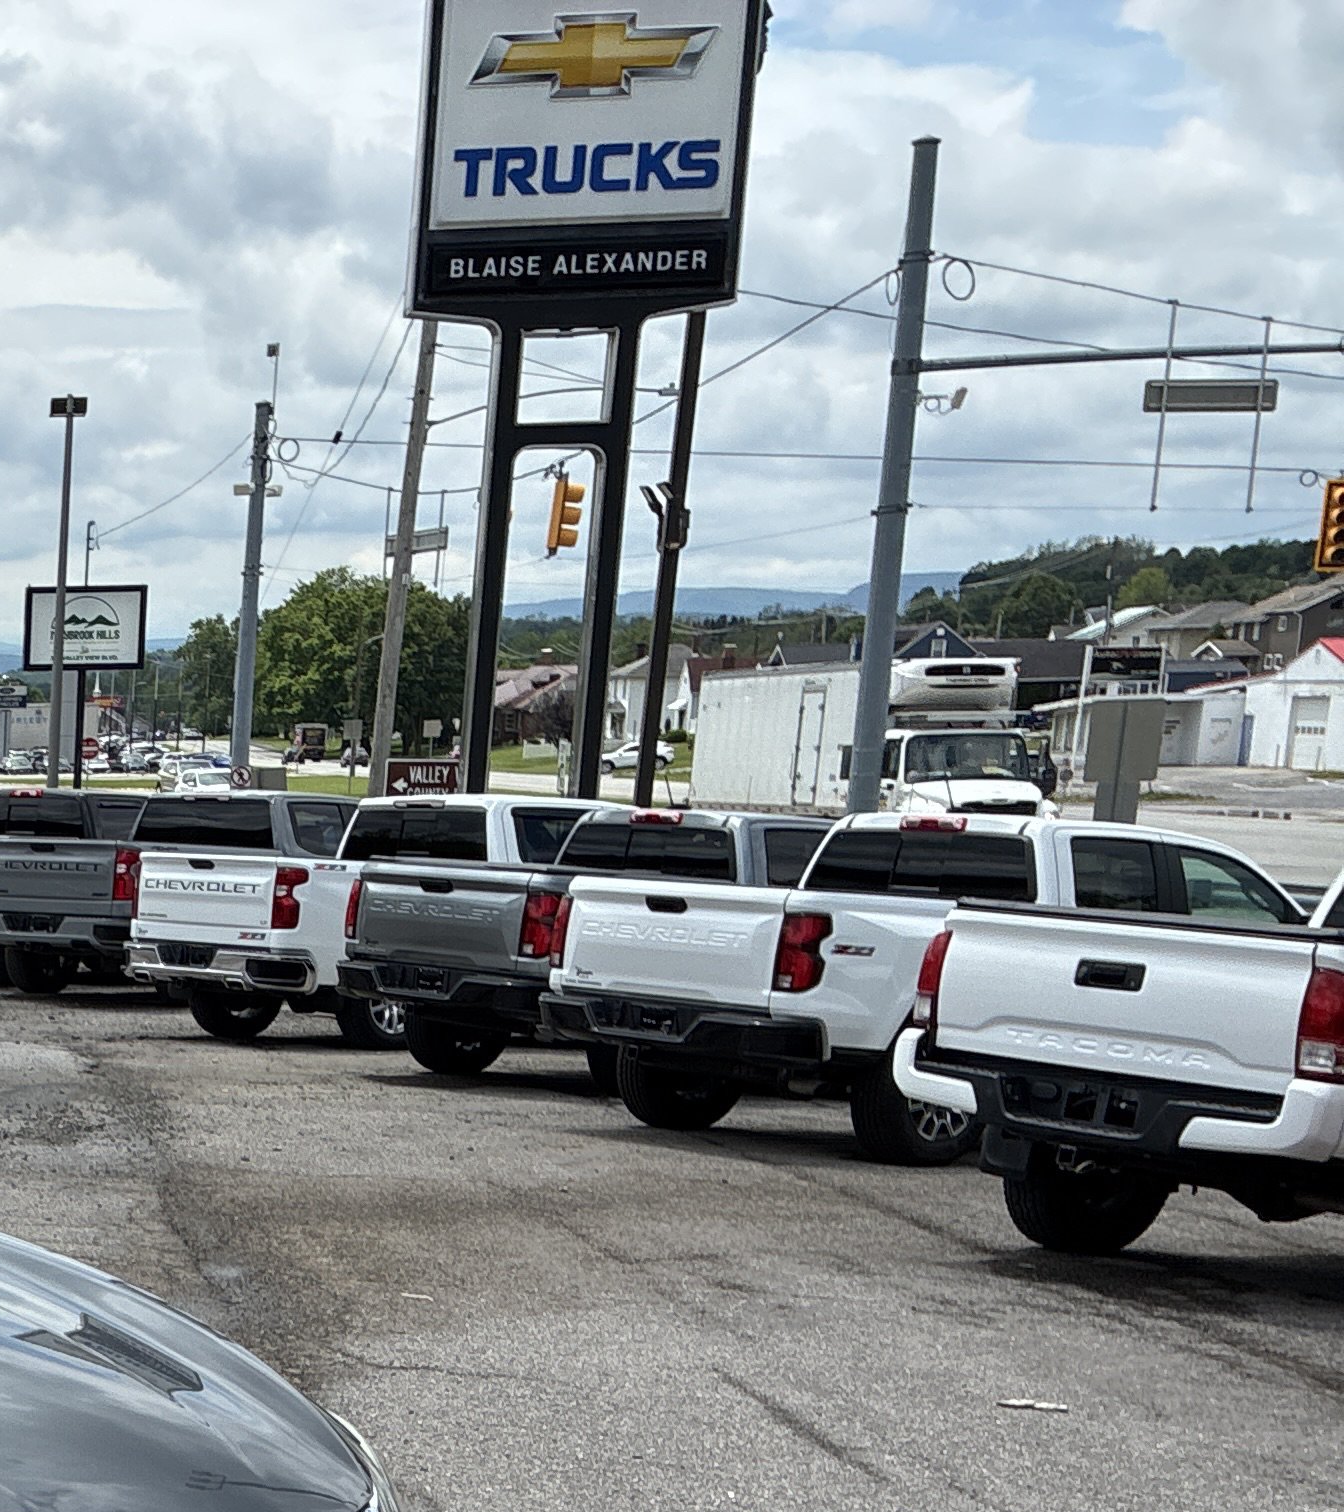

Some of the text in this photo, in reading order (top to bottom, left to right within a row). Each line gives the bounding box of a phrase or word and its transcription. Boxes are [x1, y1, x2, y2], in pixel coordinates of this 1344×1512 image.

[454, 139, 721, 197] TRUCKS
[449, 250, 708, 279] BLAISE ALEXANDER
[408, 765, 450, 784] VALLEY
[144, 878, 261, 895] CHEVROLET
[369, 899, 501, 922] CHEVROLET
[581, 919, 750, 948] CHEVROLET
[1006, 1027, 1211, 1071] TACOMA
